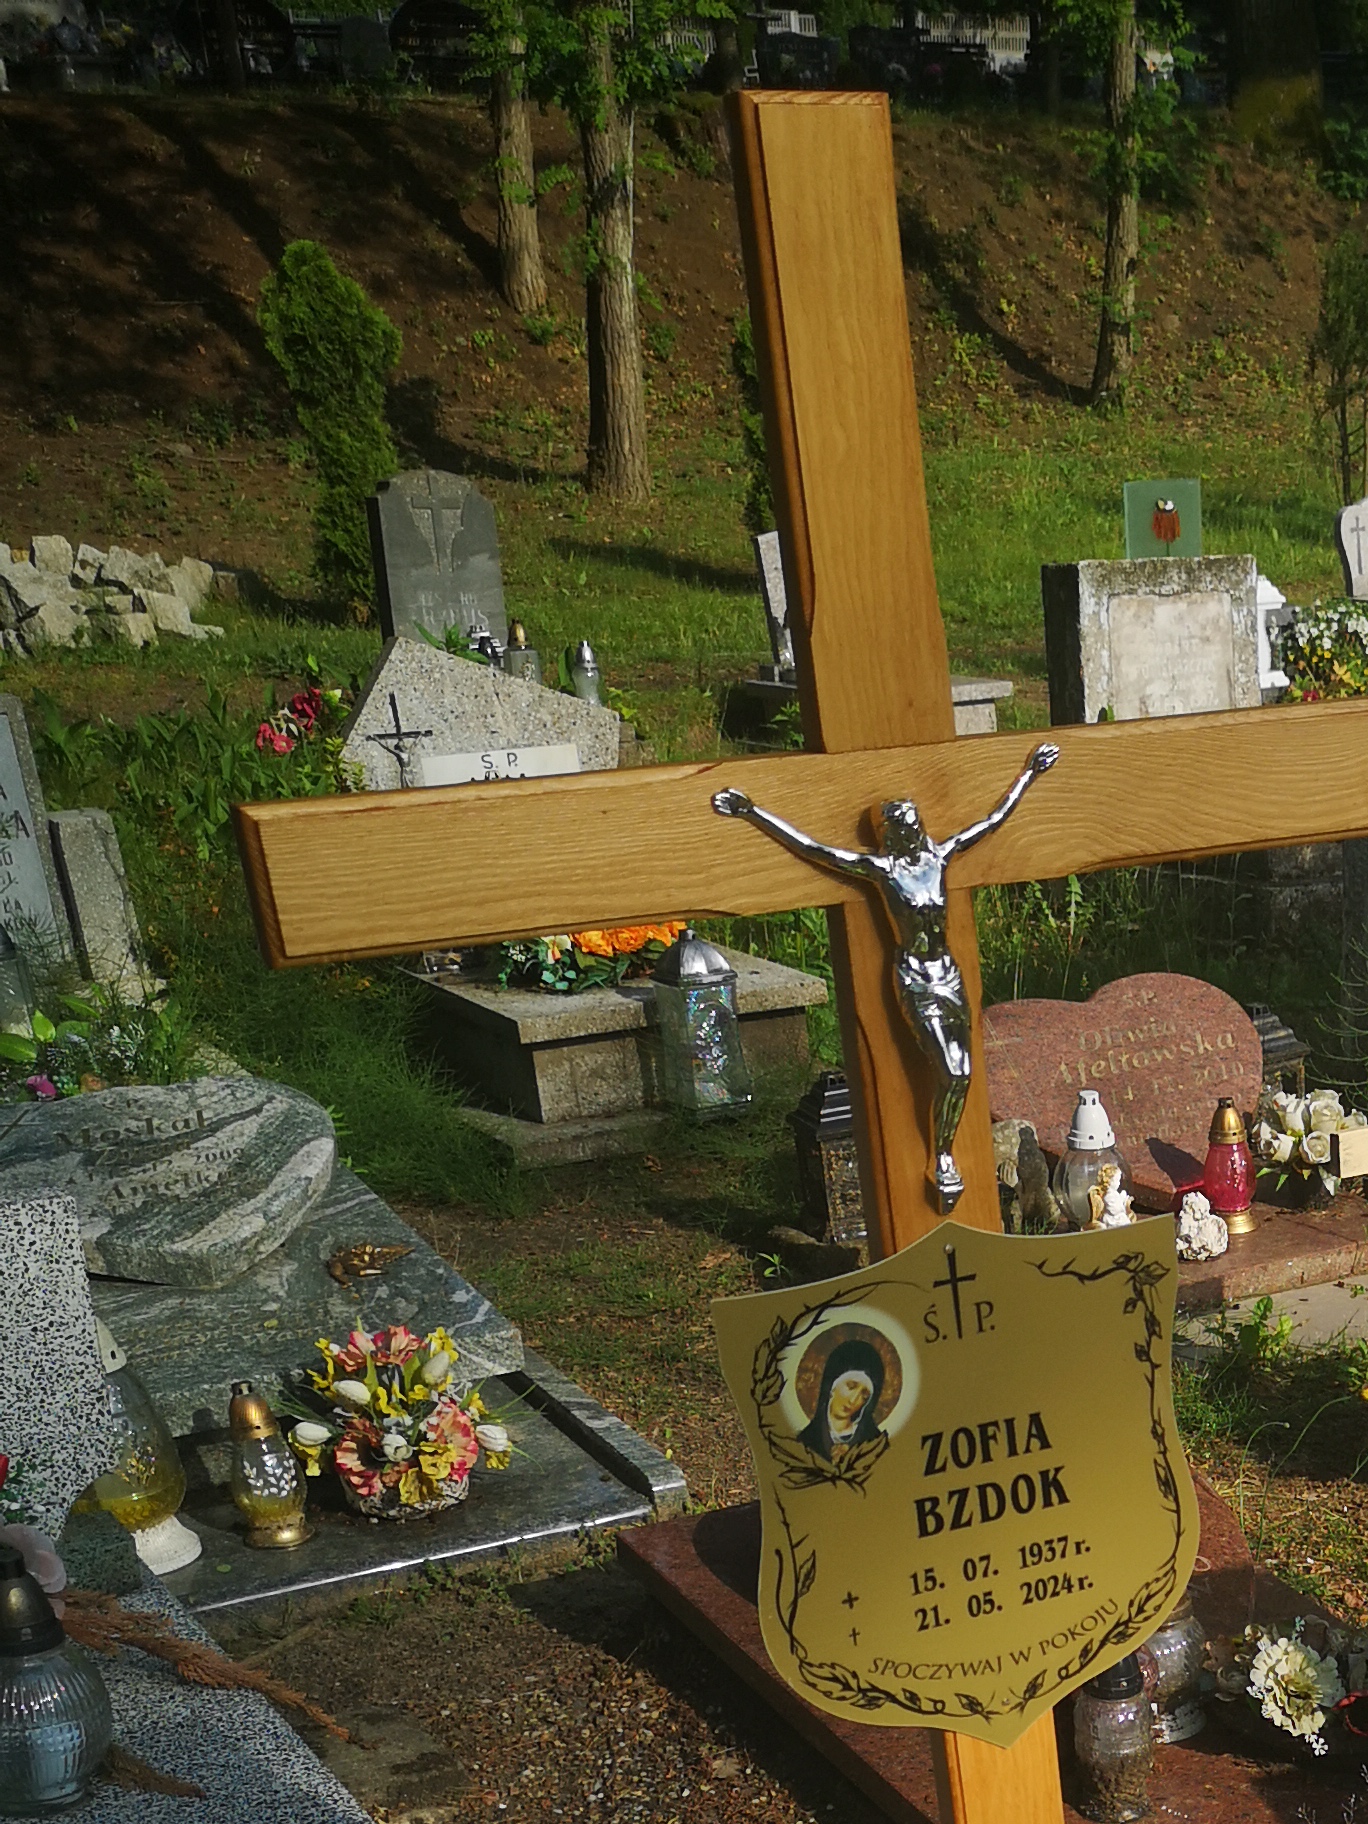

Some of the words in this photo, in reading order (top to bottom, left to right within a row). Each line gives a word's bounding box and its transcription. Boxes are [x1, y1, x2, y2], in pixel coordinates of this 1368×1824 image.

[920, 1411, 1054, 1477] ZOFIA
[913, 1465, 1071, 1539] BZDOK
[909, 1569, 946, 1596] 15.
[962, 1555, 1000, 1582] 07.
[868, 1653, 1005, 1682] SPOCZYWAJ
[1009, 1646, 1033, 1668] W
[1039, 1597, 1121, 1656] POKOJU
[914, 1606, 952, 1633] 21.
[967, 1593, 1004, 1618] 05.
